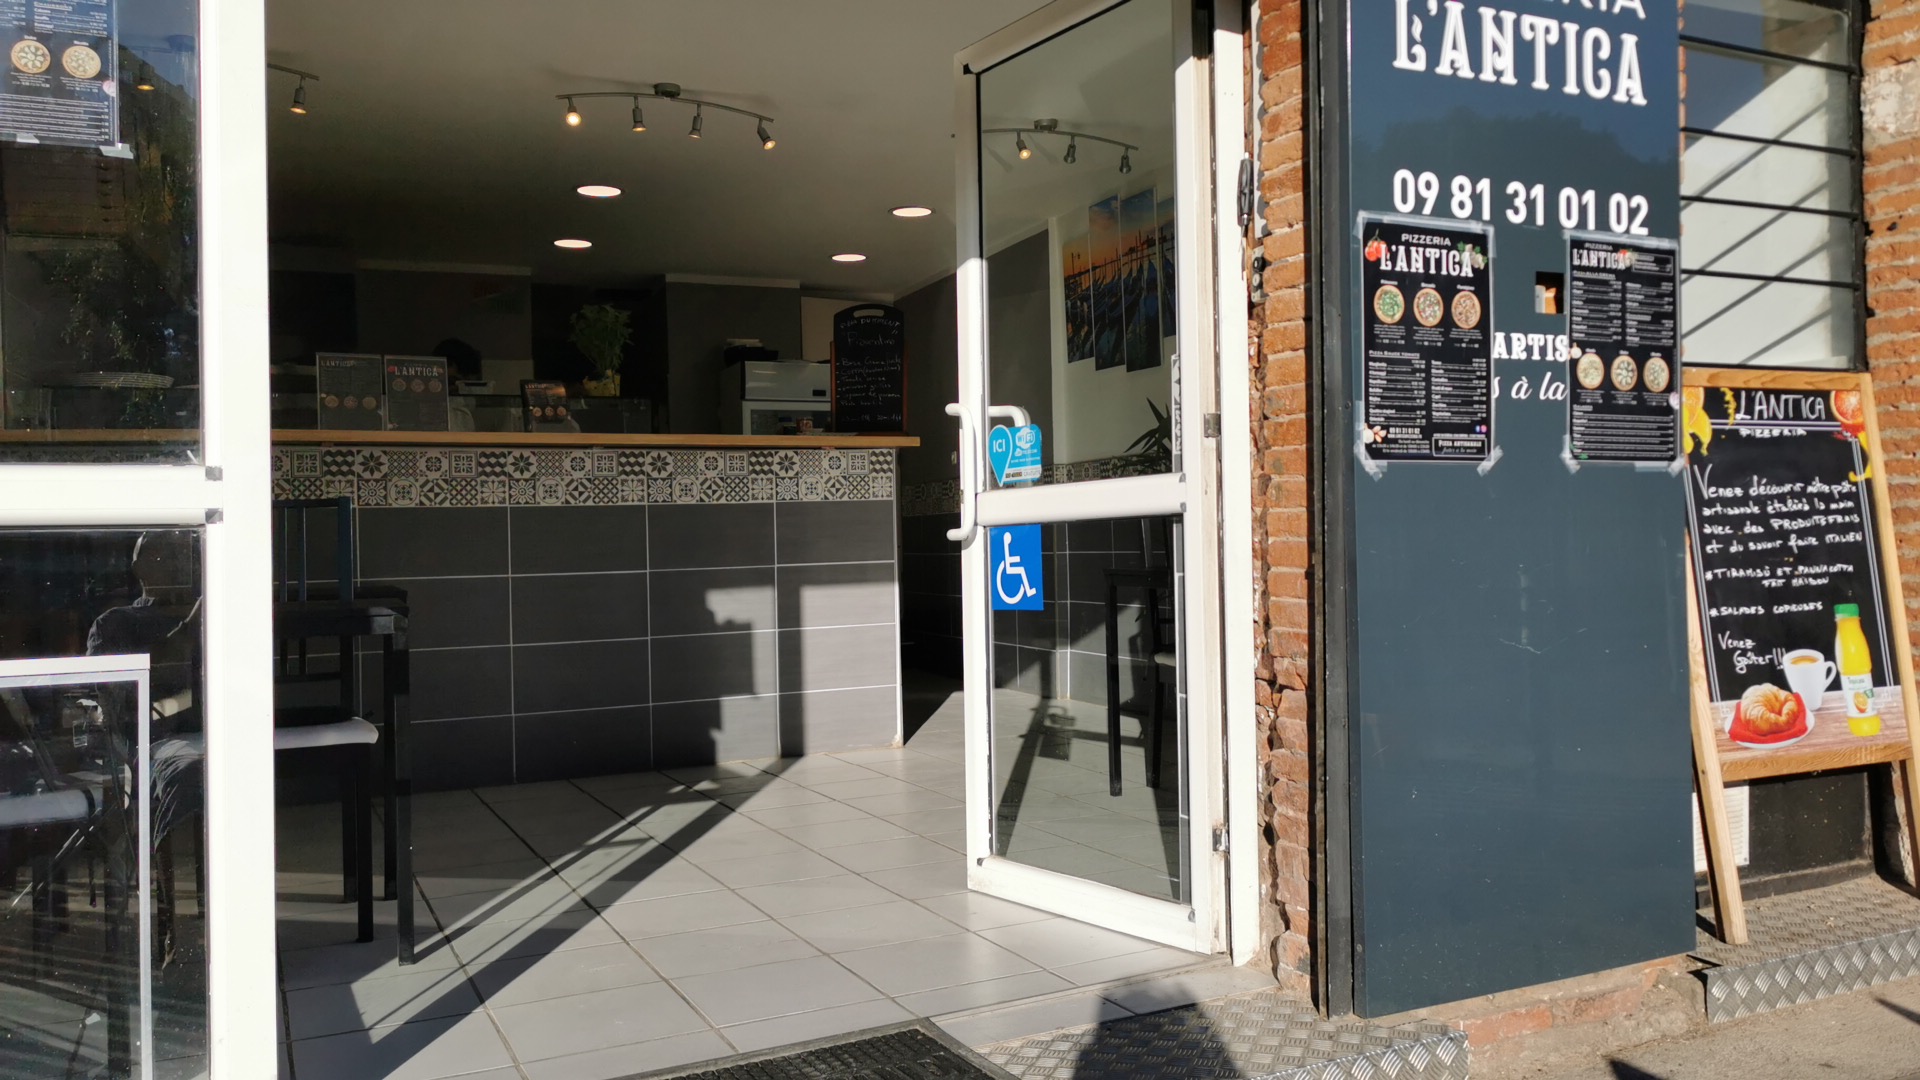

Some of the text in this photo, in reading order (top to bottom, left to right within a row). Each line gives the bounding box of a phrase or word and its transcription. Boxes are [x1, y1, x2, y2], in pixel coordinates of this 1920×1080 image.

[1392, 0, 1648, 106] L'ANTICA
[1393, 168, 1649, 235] 09 81 31 01 02
[1401, 233, 1452, 247] PIZZERIA
[1380, 244, 1474, 277] L'ANTICA
[1735, 389, 1826, 420] L'ANTICA
[1739, 428, 1807, 438] PIZZERIA
[993, 438, 1006, 453] ICI
[1692, 463, 1745, 500] Venez
[1829, 499, 1855, 511] main
[1702, 523, 1734, 535] avec
[1743, 520, 1765, 533] des
[1705, 540, 1724, 554] et
[1729, 540, 1744, 553] du
[1786, 533, 1820, 554] faire
[1824, 531, 1863, 544] ITALIEN
[1776, 566, 1793, 576] ET
[1717, 630, 1756, 650] Venez
